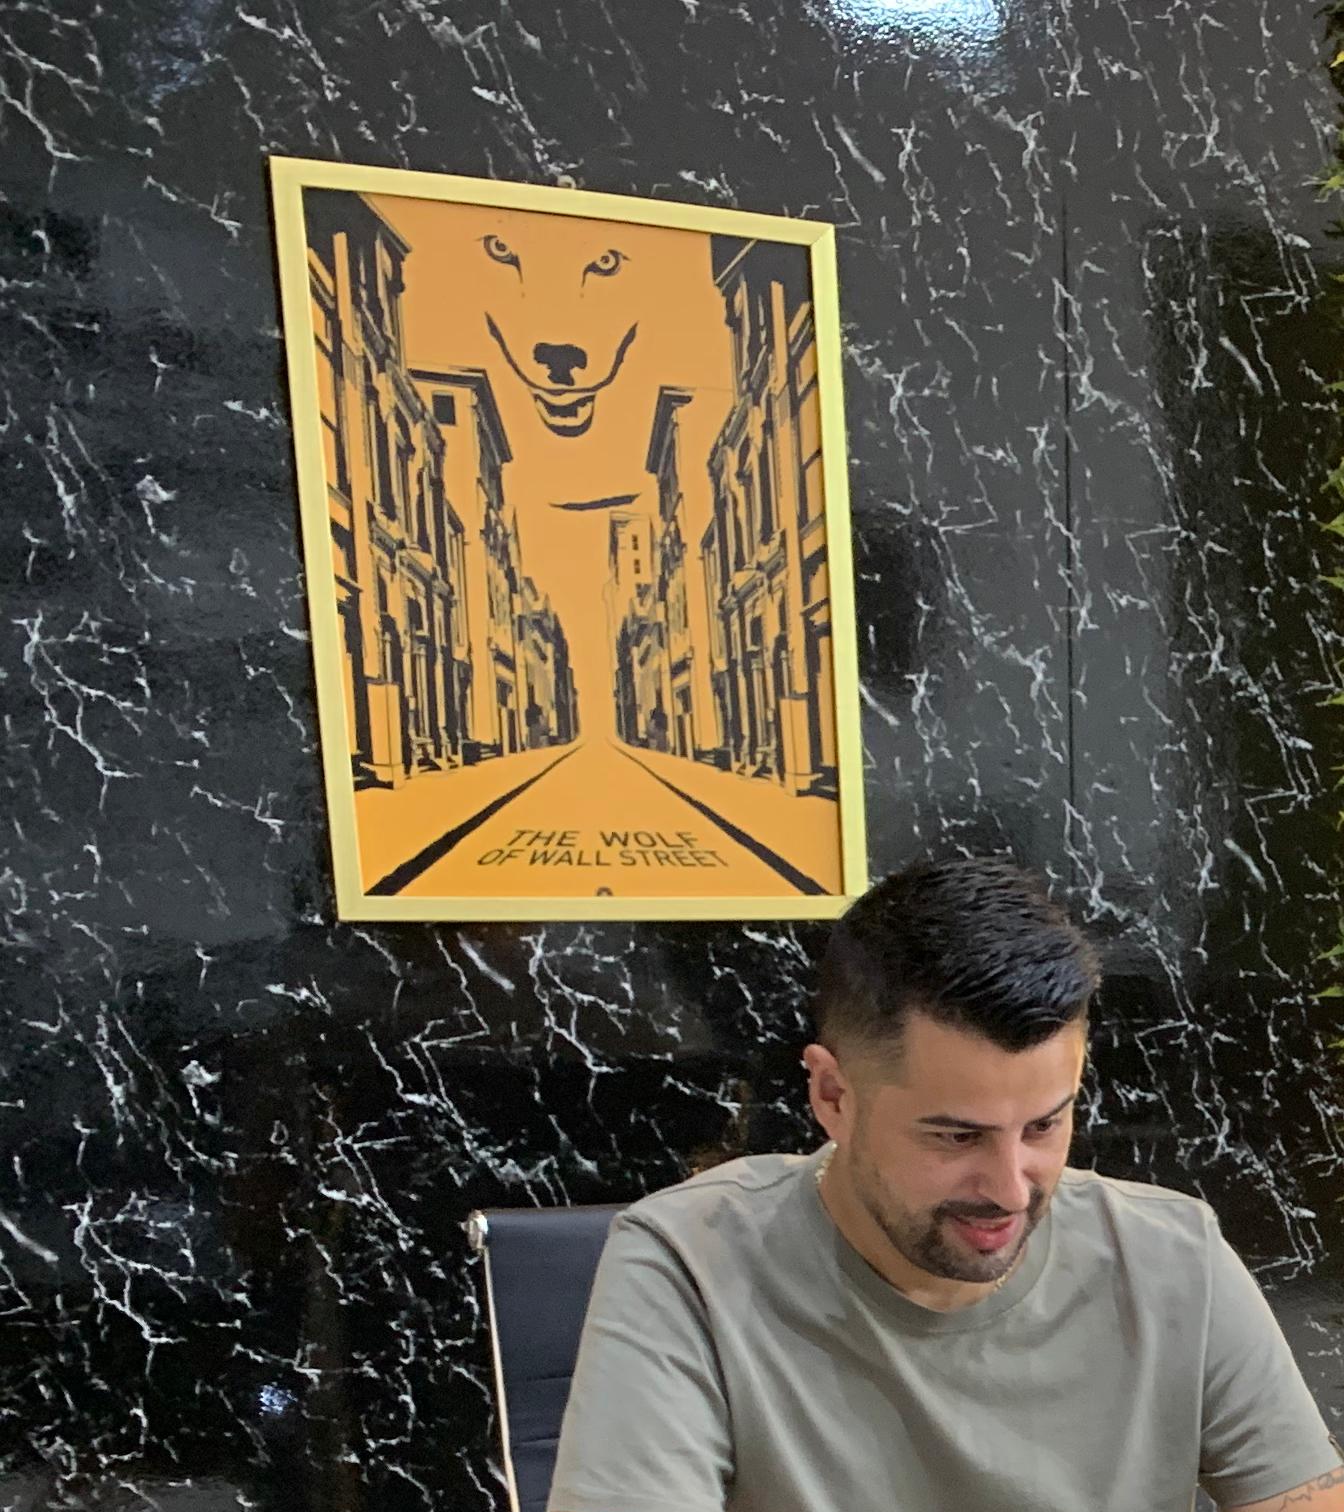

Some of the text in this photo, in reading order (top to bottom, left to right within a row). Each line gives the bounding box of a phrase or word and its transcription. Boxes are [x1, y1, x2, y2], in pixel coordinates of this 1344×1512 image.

[507, 830, 699, 849] THE WOLF
[477, 848, 729, 868] OF WALL STREET
